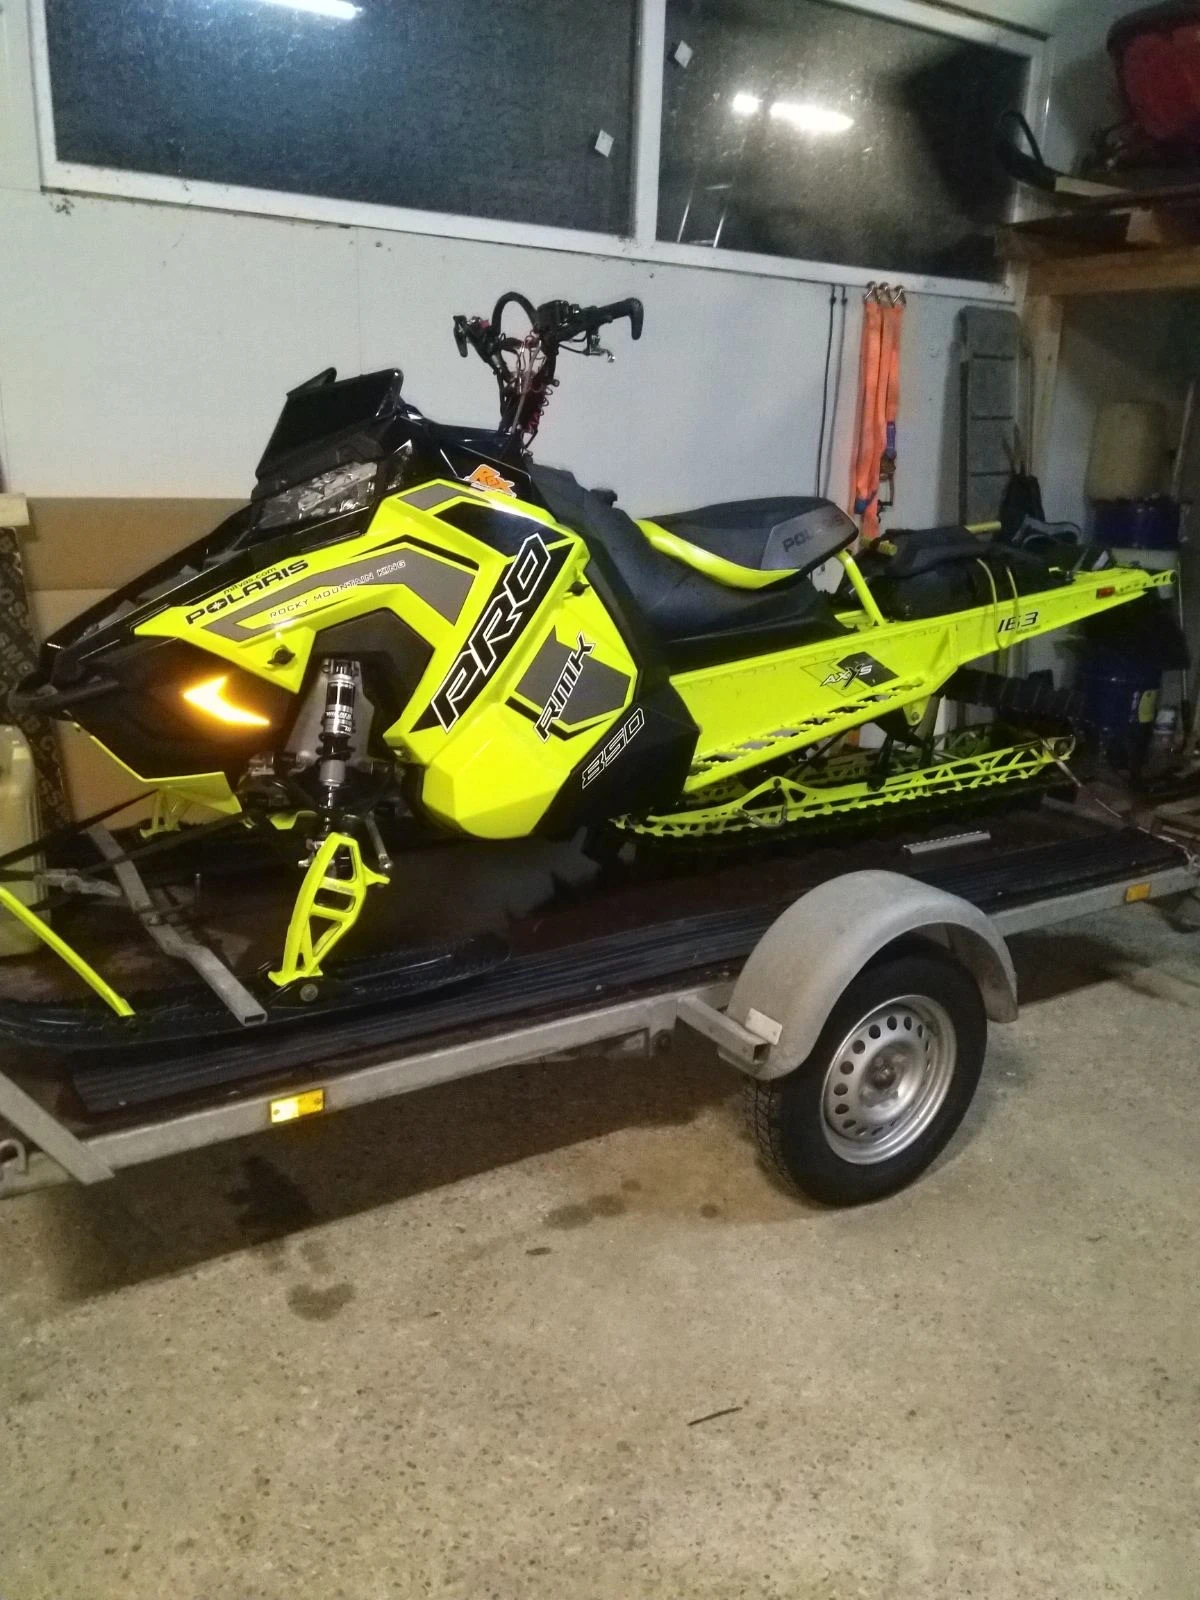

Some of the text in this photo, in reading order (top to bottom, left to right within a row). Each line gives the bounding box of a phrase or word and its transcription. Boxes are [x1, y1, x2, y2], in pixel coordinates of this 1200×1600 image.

[185, 559, 309, 625] POLARIS
[269, 560, 406, 618] ROCKY MOUNTAIN KING
[997, 611, 1039, 633] 163
[431, 533, 551, 734] PRO
[533, 629, 596, 744] RMK
[819, 663, 873, 691] AXYS
[582, 707, 645, 789] 850
